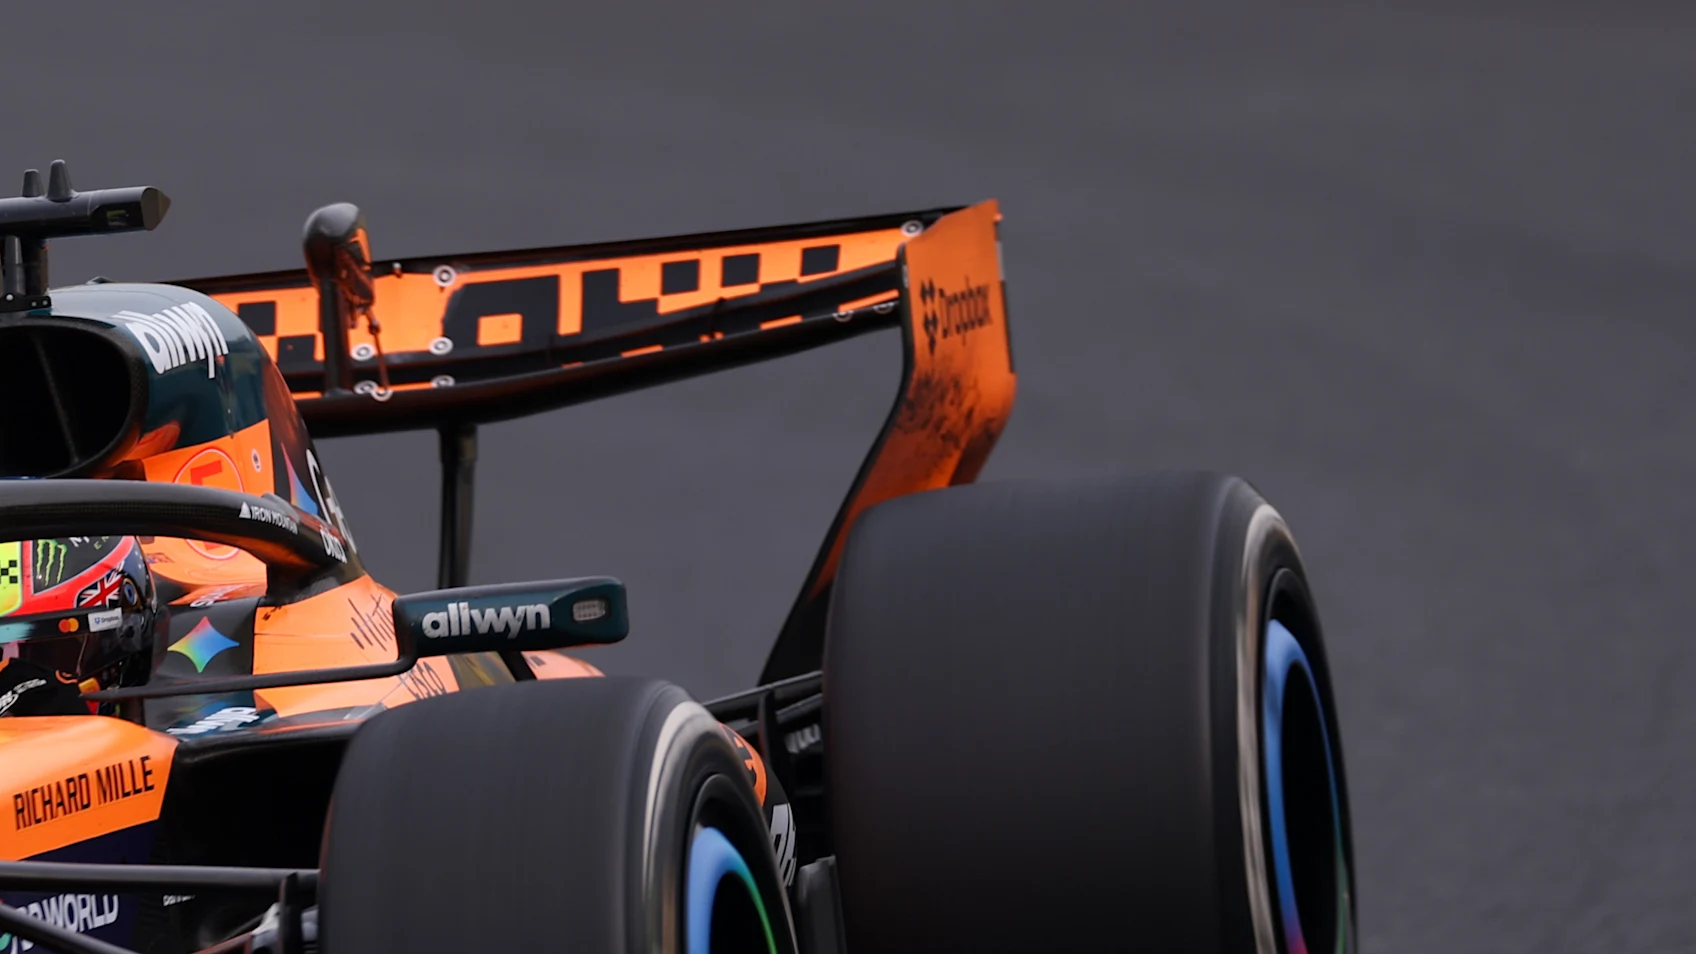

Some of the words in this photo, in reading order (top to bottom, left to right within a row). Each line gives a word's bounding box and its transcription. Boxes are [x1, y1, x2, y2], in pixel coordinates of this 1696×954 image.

[938, 274, 991, 346] Dropbox
[110, 301, 230, 379] allwyn
[251, 505, 272, 524] IRON
[421, 601, 551, 639] allwyn
[13, 773, 91, 831] RICHARD
[95, 755, 155, 806] MILLE
[42, 893, 119, 934] WORLD
